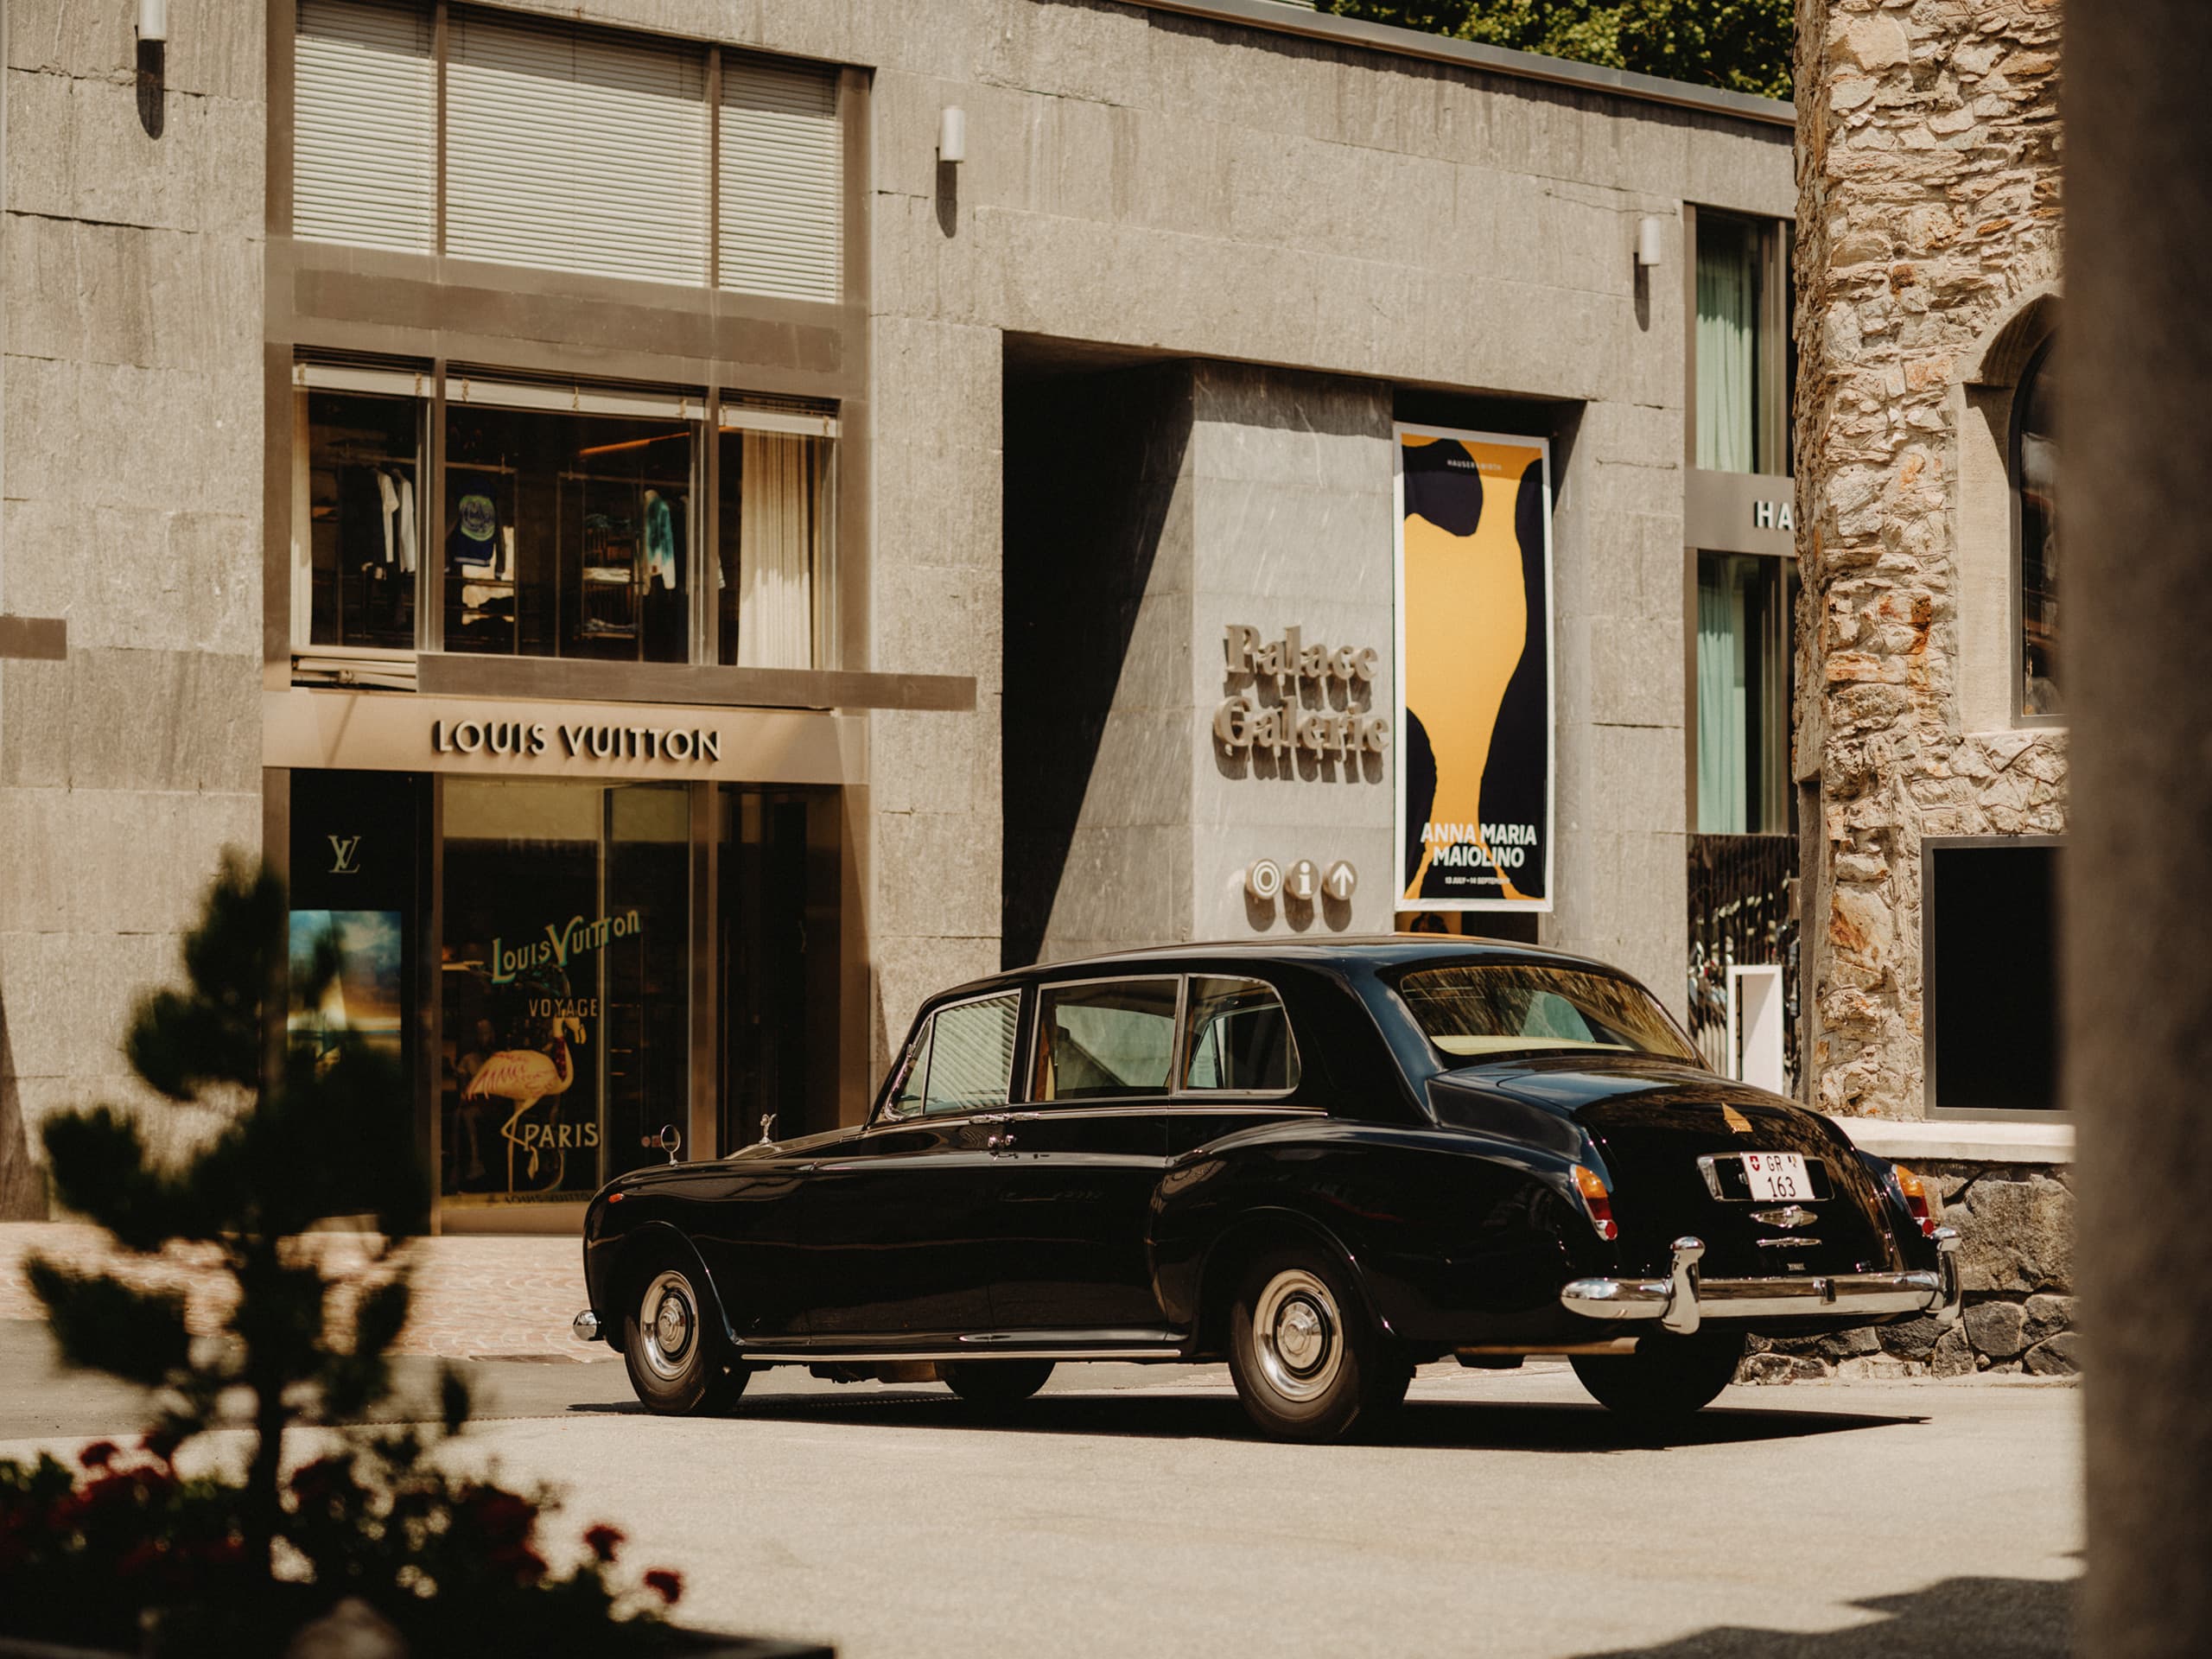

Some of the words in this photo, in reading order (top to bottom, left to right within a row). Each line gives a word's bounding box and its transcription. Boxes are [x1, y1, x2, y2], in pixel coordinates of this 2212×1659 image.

[1754, 500, 1794, 530] HA
[1224, 625, 1378, 681] Palace
[1213, 695, 1389, 752] Galerie
[434, 720, 548, 756] LOUIS
[559, 724, 722, 762] VUITTON
[1420, 822, 1478, 843] ANNA
[1479, 823, 1537, 846] MARIA
[327, 835, 361, 874] LV
[1432, 845, 1525, 868] MAIOLINO
[529, 998, 598, 1018] VOYAGE
[524, 1122, 600, 1152] PARIS
[1766, 1155, 1783, 1172] GR
[1767, 1176, 1796, 1198] 163
